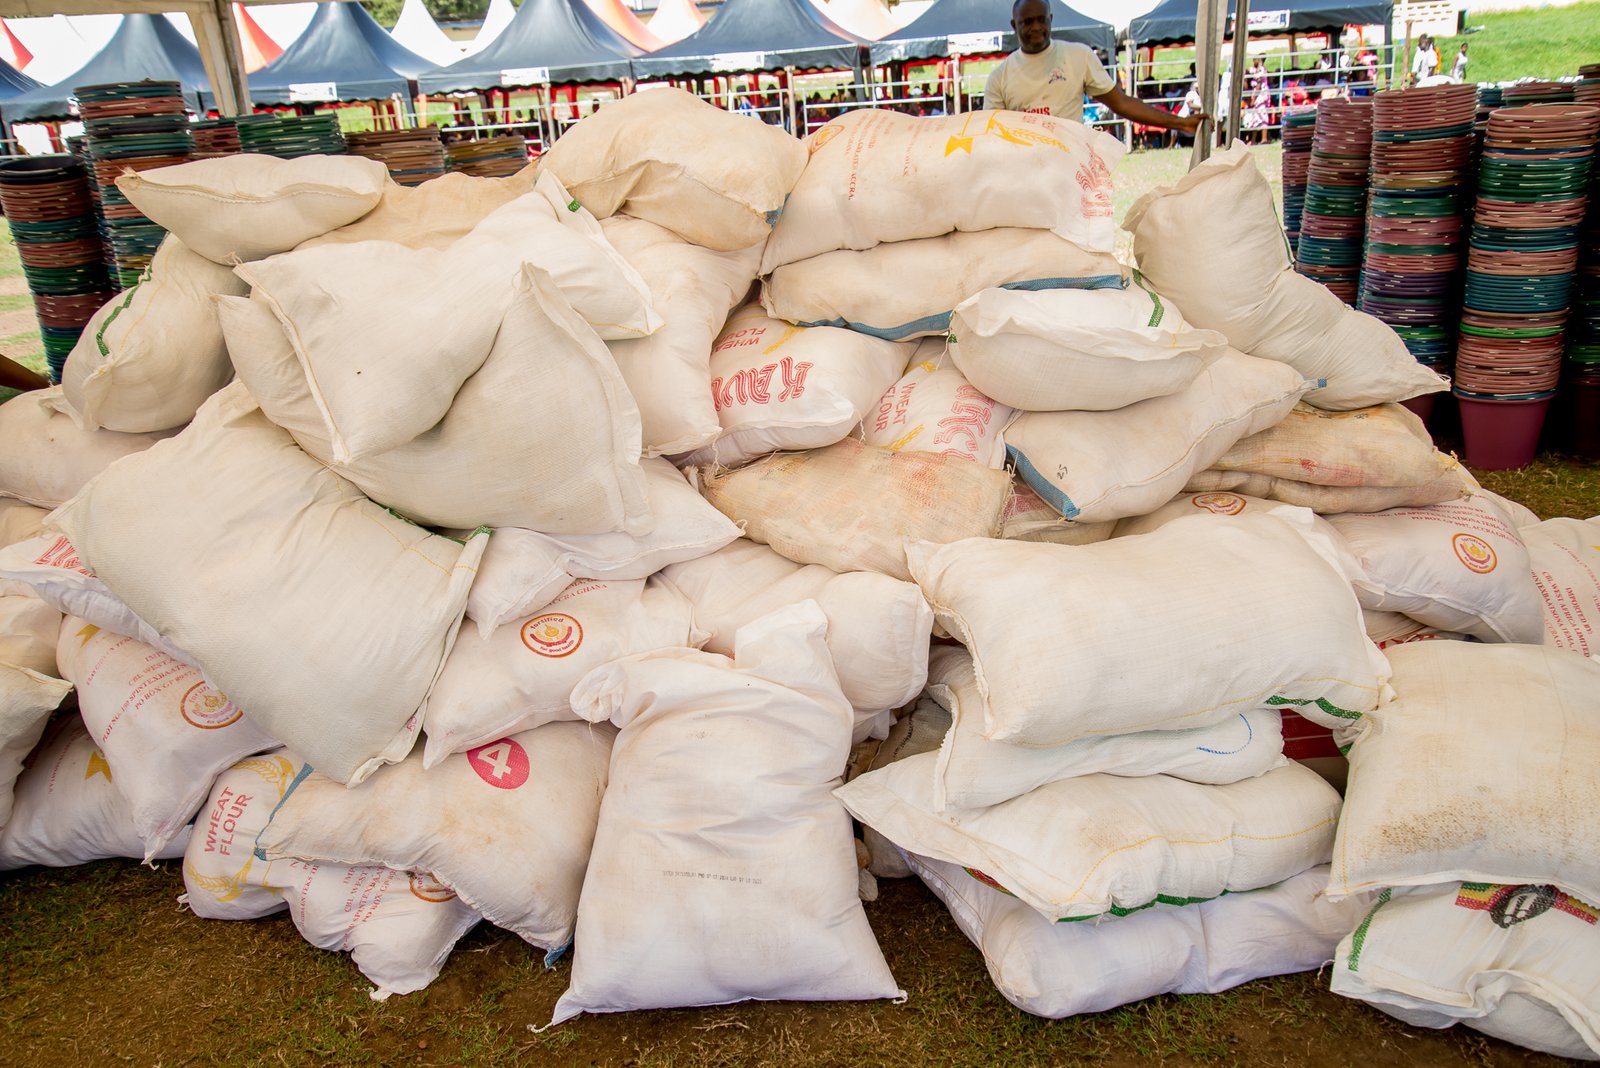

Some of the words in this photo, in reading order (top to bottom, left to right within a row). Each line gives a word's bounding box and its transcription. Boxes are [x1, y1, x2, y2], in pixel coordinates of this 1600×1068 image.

[893, 382, 917, 425] WHEAT
[576, 583, 608, 595] GHANA
[1565, 586, 1587, 624] IMPORTED
[530, 617, 564, 630] fortified
[1551, 583, 1564, 602] WEST
[1560, 602, 1577, 629] AFRICA
[1574, 626, 1591, 658] LIMITED
[477, 742, 512, 780] 4
[204, 786, 234, 852] WHEAT
[219, 794, 254, 856] FLOUR
